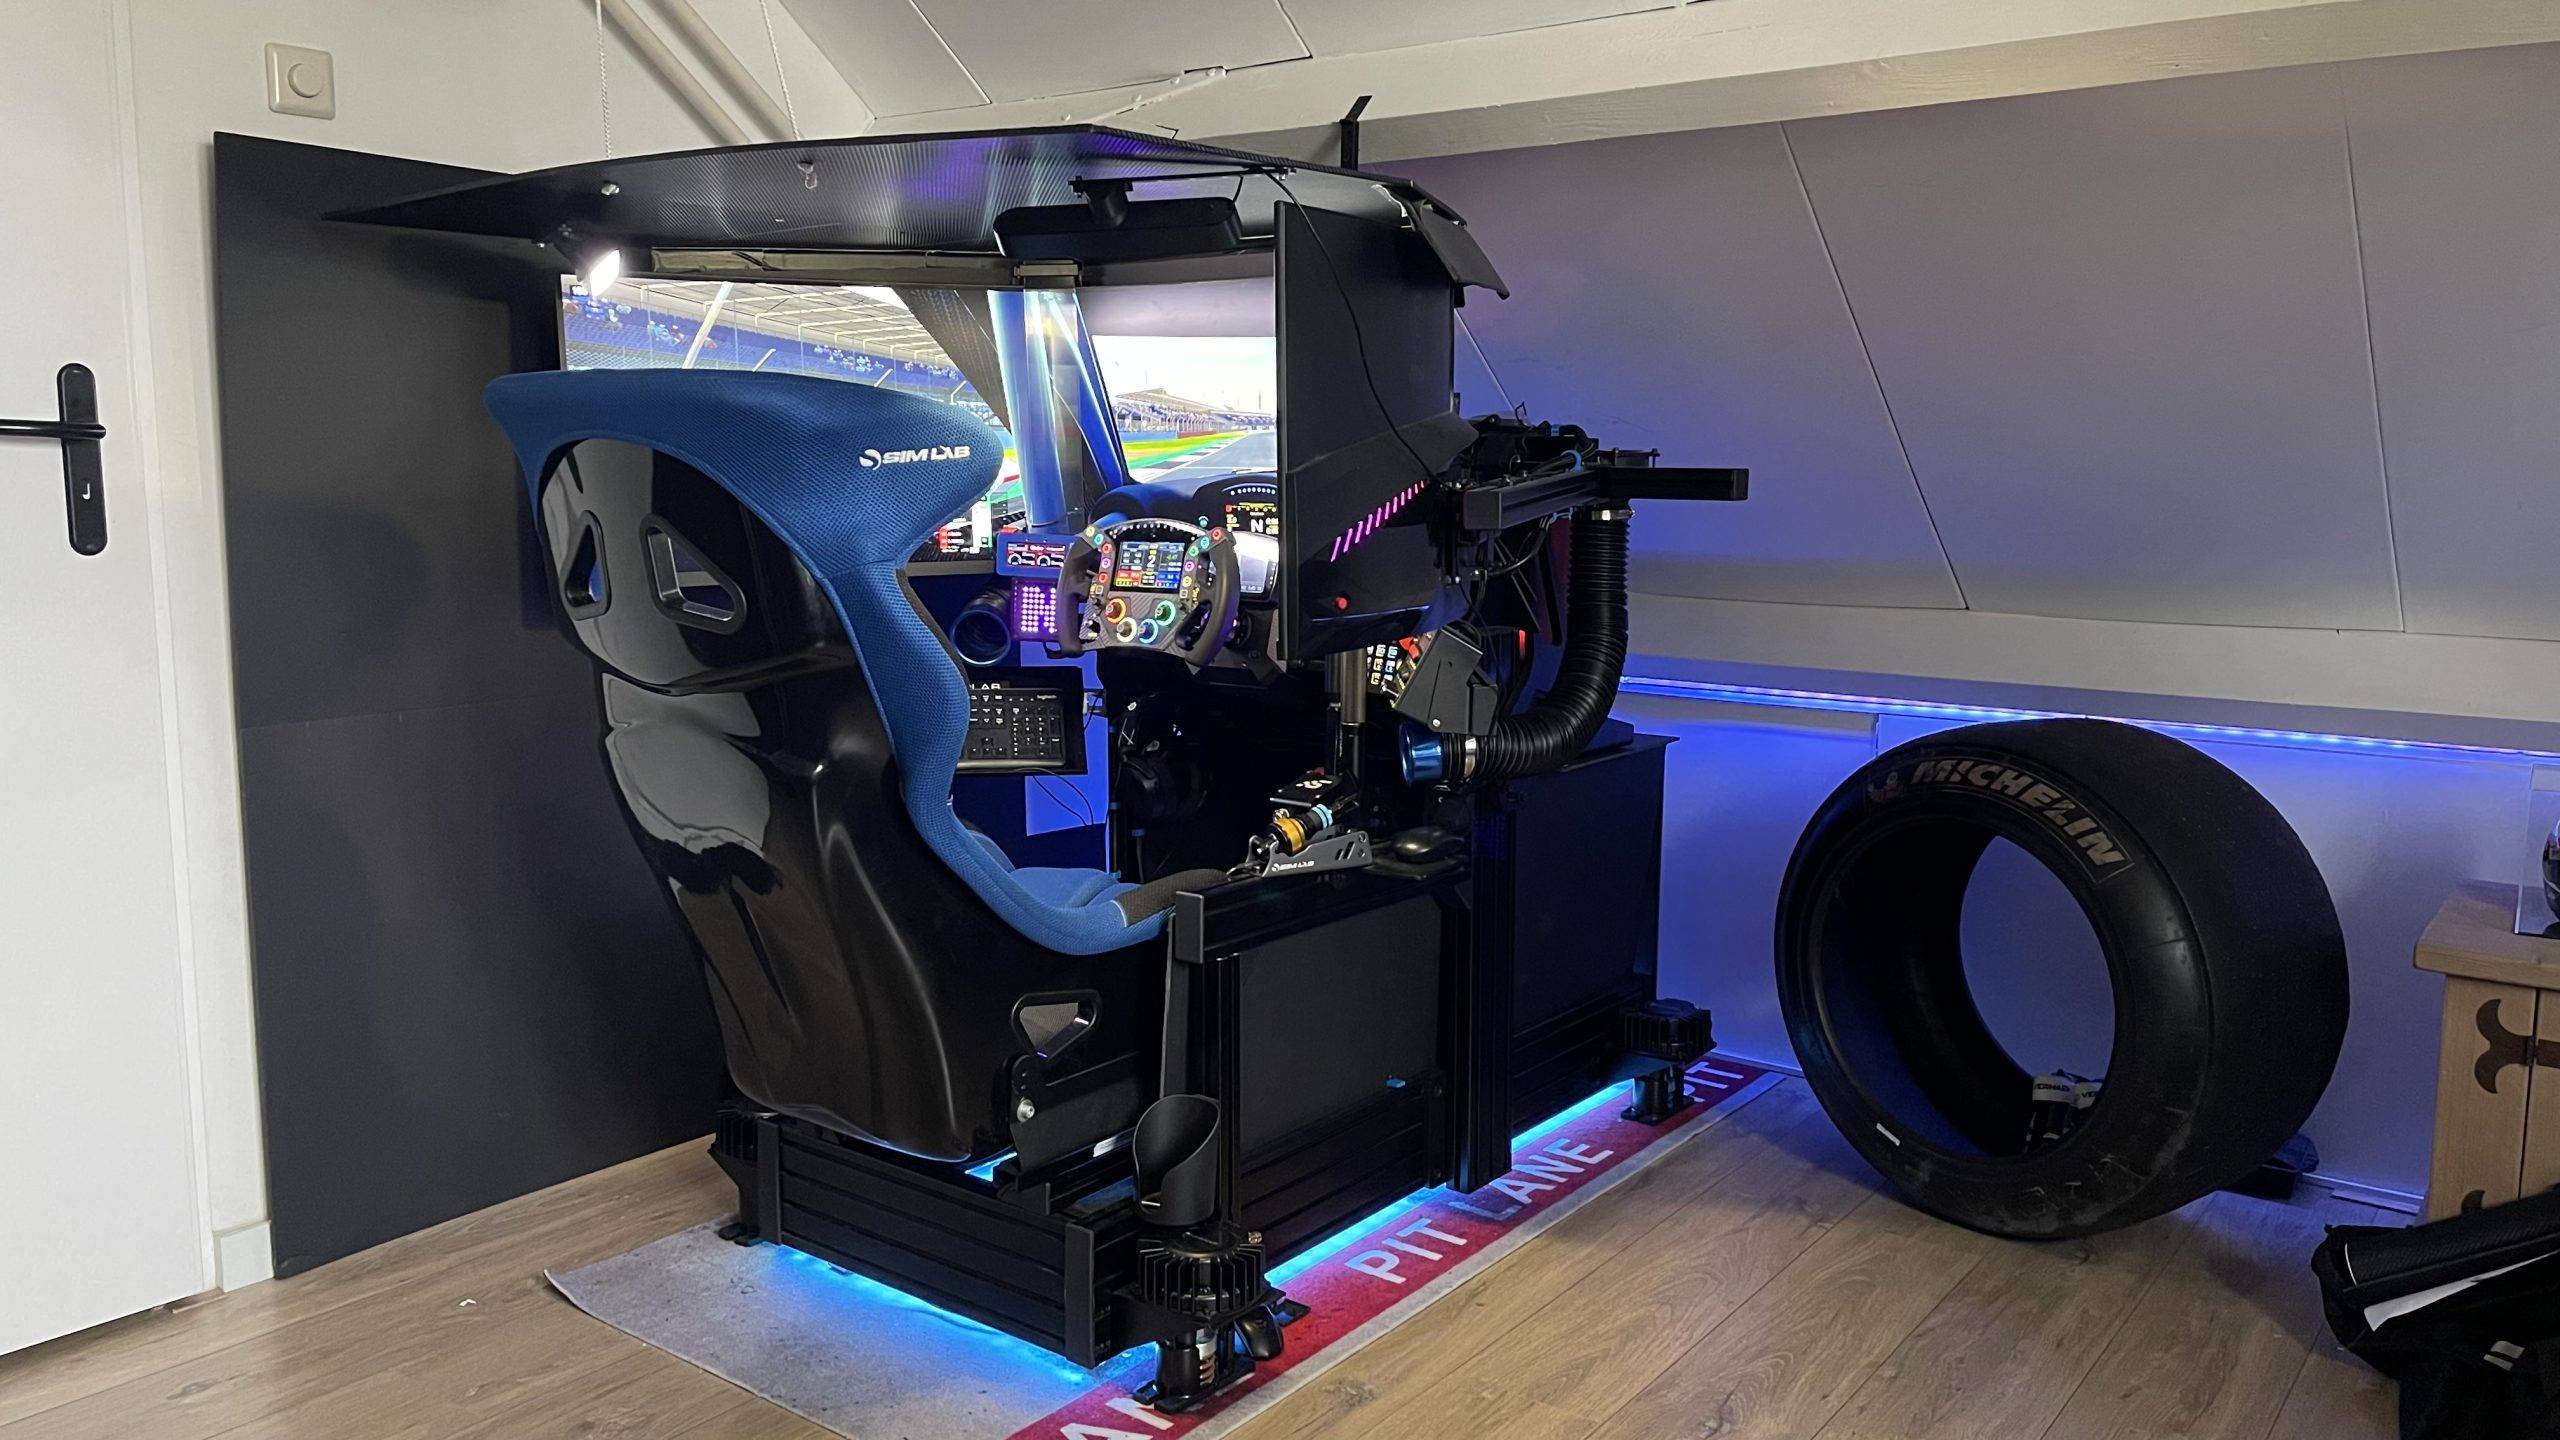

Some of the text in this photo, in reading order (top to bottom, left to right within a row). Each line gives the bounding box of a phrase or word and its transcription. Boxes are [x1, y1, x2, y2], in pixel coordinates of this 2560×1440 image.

[882, 445, 971, 464] SIM LAB
[1250, 518, 1264, 533] N
[1146, 554, 1157, 568] 2
[1911, 759, 2126, 866] MICHELIN
[1345, 1218, 1468, 1284] PIT
[1447, 1138, 1614, 1221] LANE
